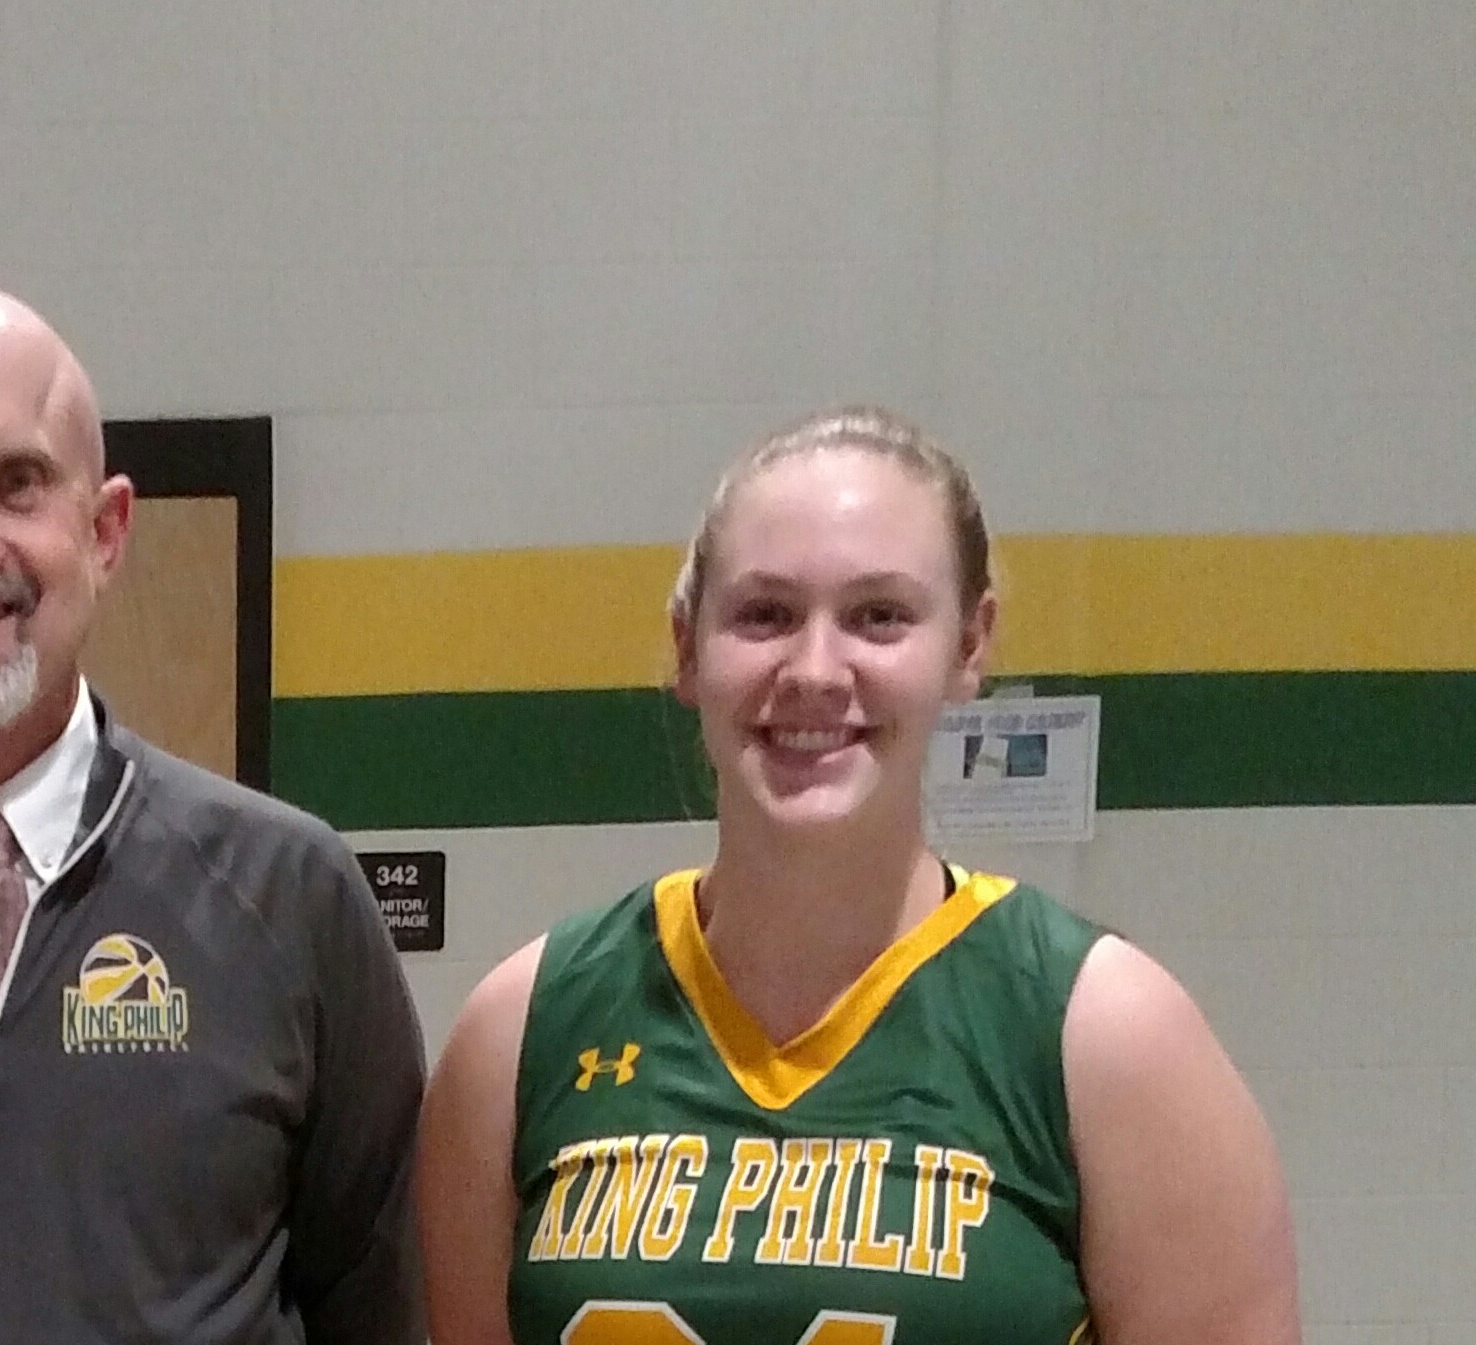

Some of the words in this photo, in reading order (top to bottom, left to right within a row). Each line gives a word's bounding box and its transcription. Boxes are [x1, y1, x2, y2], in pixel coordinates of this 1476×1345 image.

[376, 865, 419, 886] 342
[380, 899, 429, 912] NITOR/
[383, 914, 429, 928] ORAGE
[65, 989, 119, 1044] KING
[124, 991, 186, 1043] PHILIP
[528, 1133, 708, 1262] KING
[702, 1137, 995, 1281] PHILIP
